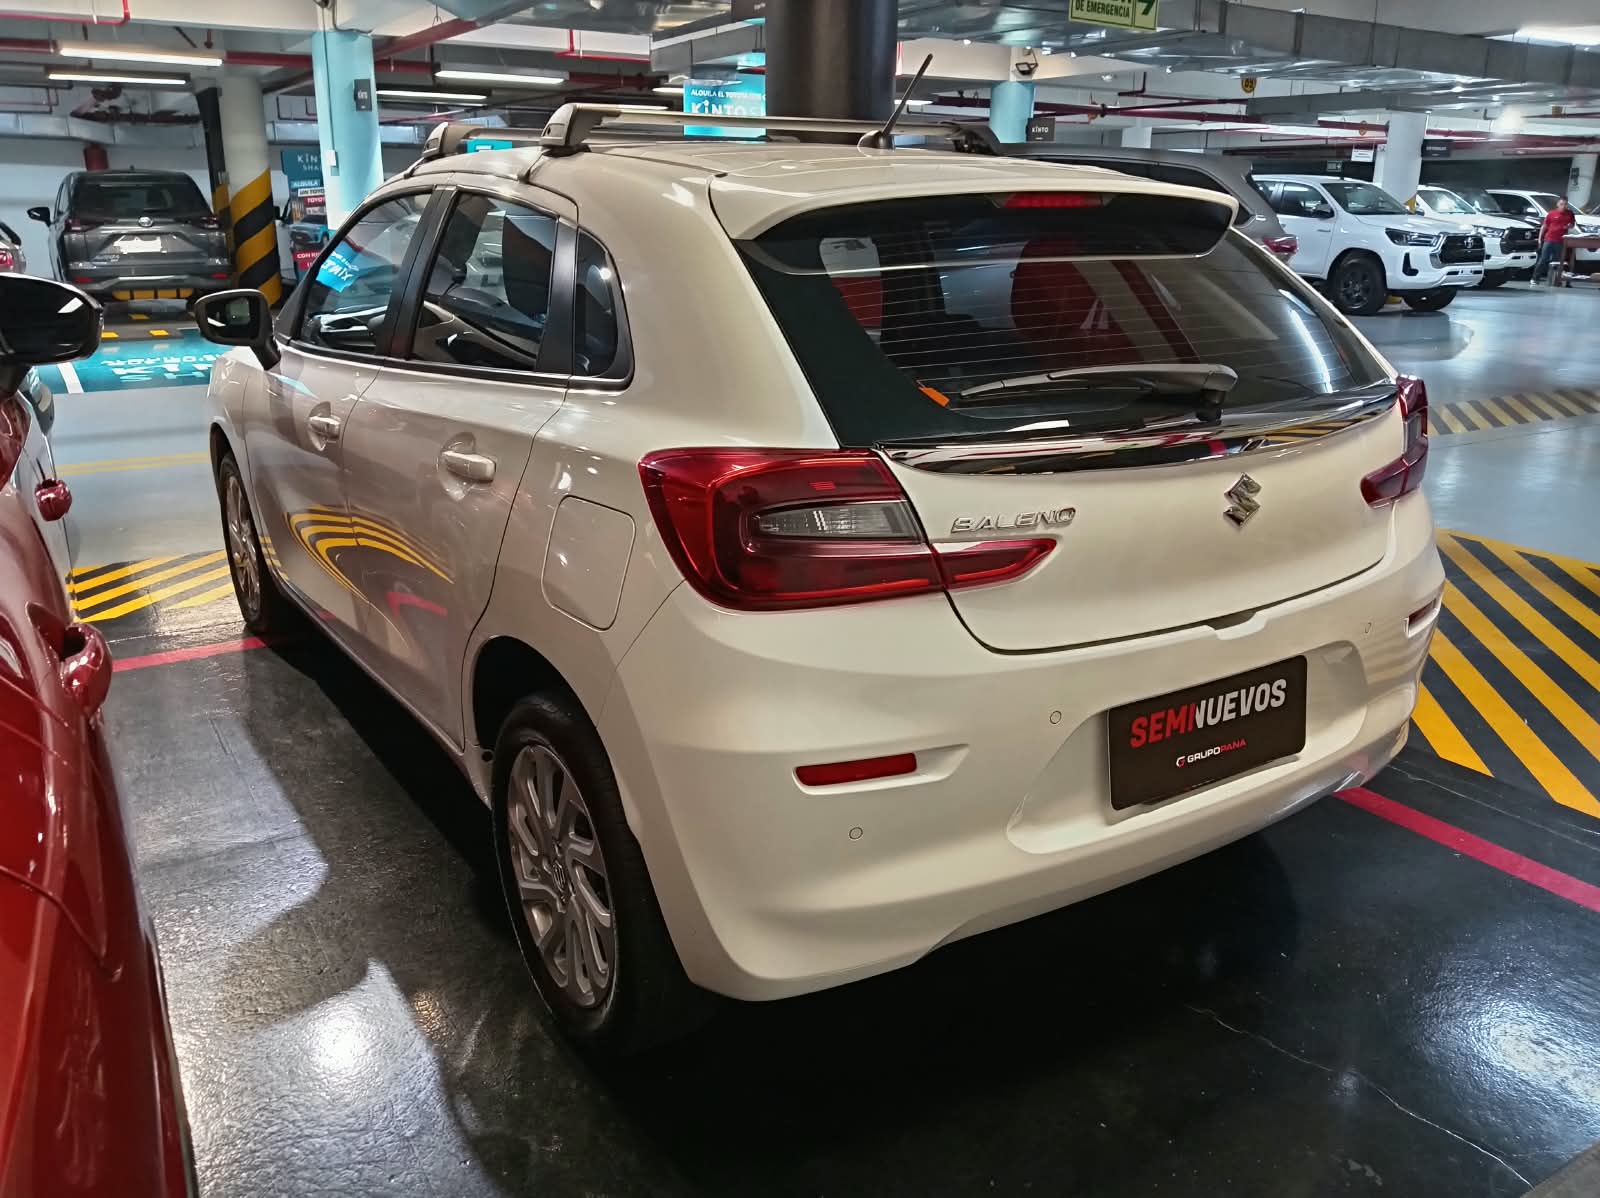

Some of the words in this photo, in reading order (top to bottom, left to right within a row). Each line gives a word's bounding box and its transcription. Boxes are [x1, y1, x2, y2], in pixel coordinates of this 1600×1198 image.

[1075, 0, 1084, 11] DE
[1086, 0, 1130, 17] EMERGENCIA
[691, 88, 717, 97] ALQUILA
[951, 507, 1077, 533] BALENO
[1129, 678, 1287, 748] SEMINUEVOS
